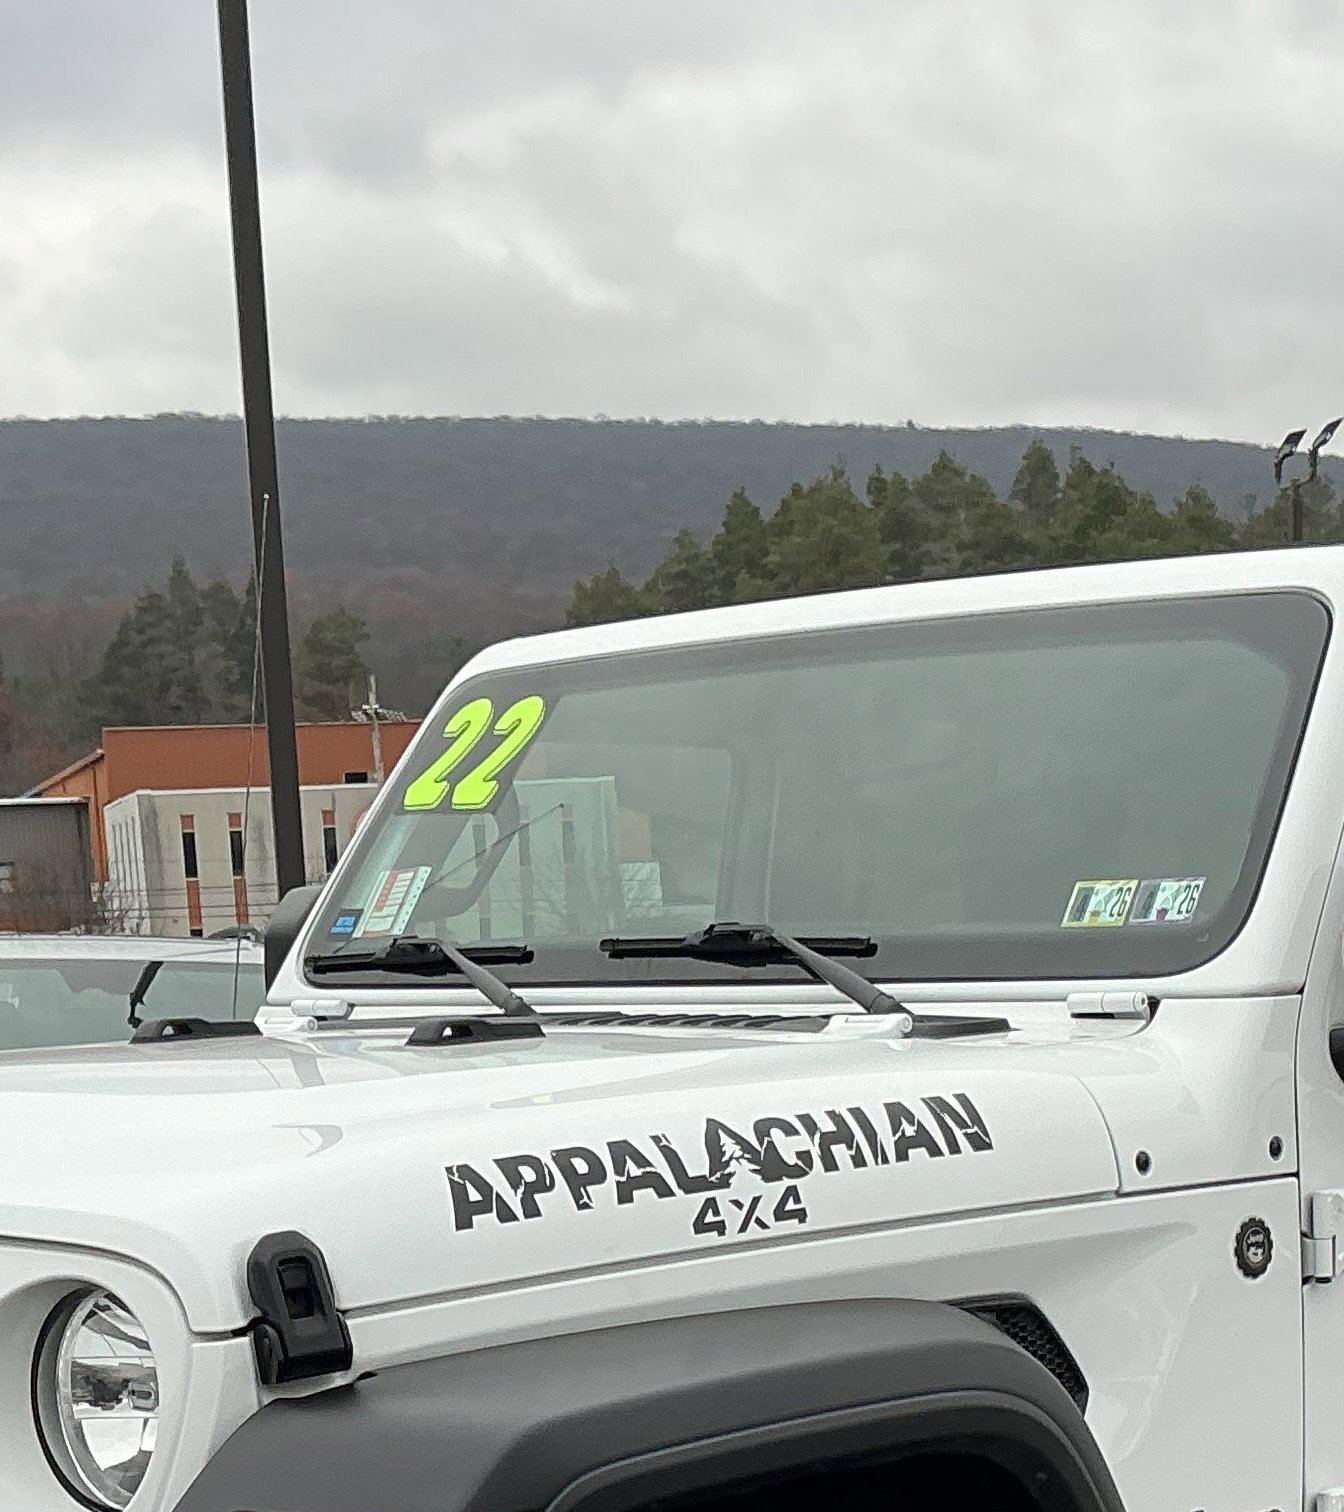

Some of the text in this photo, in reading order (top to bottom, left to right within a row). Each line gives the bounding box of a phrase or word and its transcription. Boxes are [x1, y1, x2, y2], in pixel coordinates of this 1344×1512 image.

[403, 695, 546, 812] 22
[1109, 886, 1132, 919] 26
[1176, 884, 1200, 916] 26
[444, 1092, 994, 1233] APPALACHIAN
